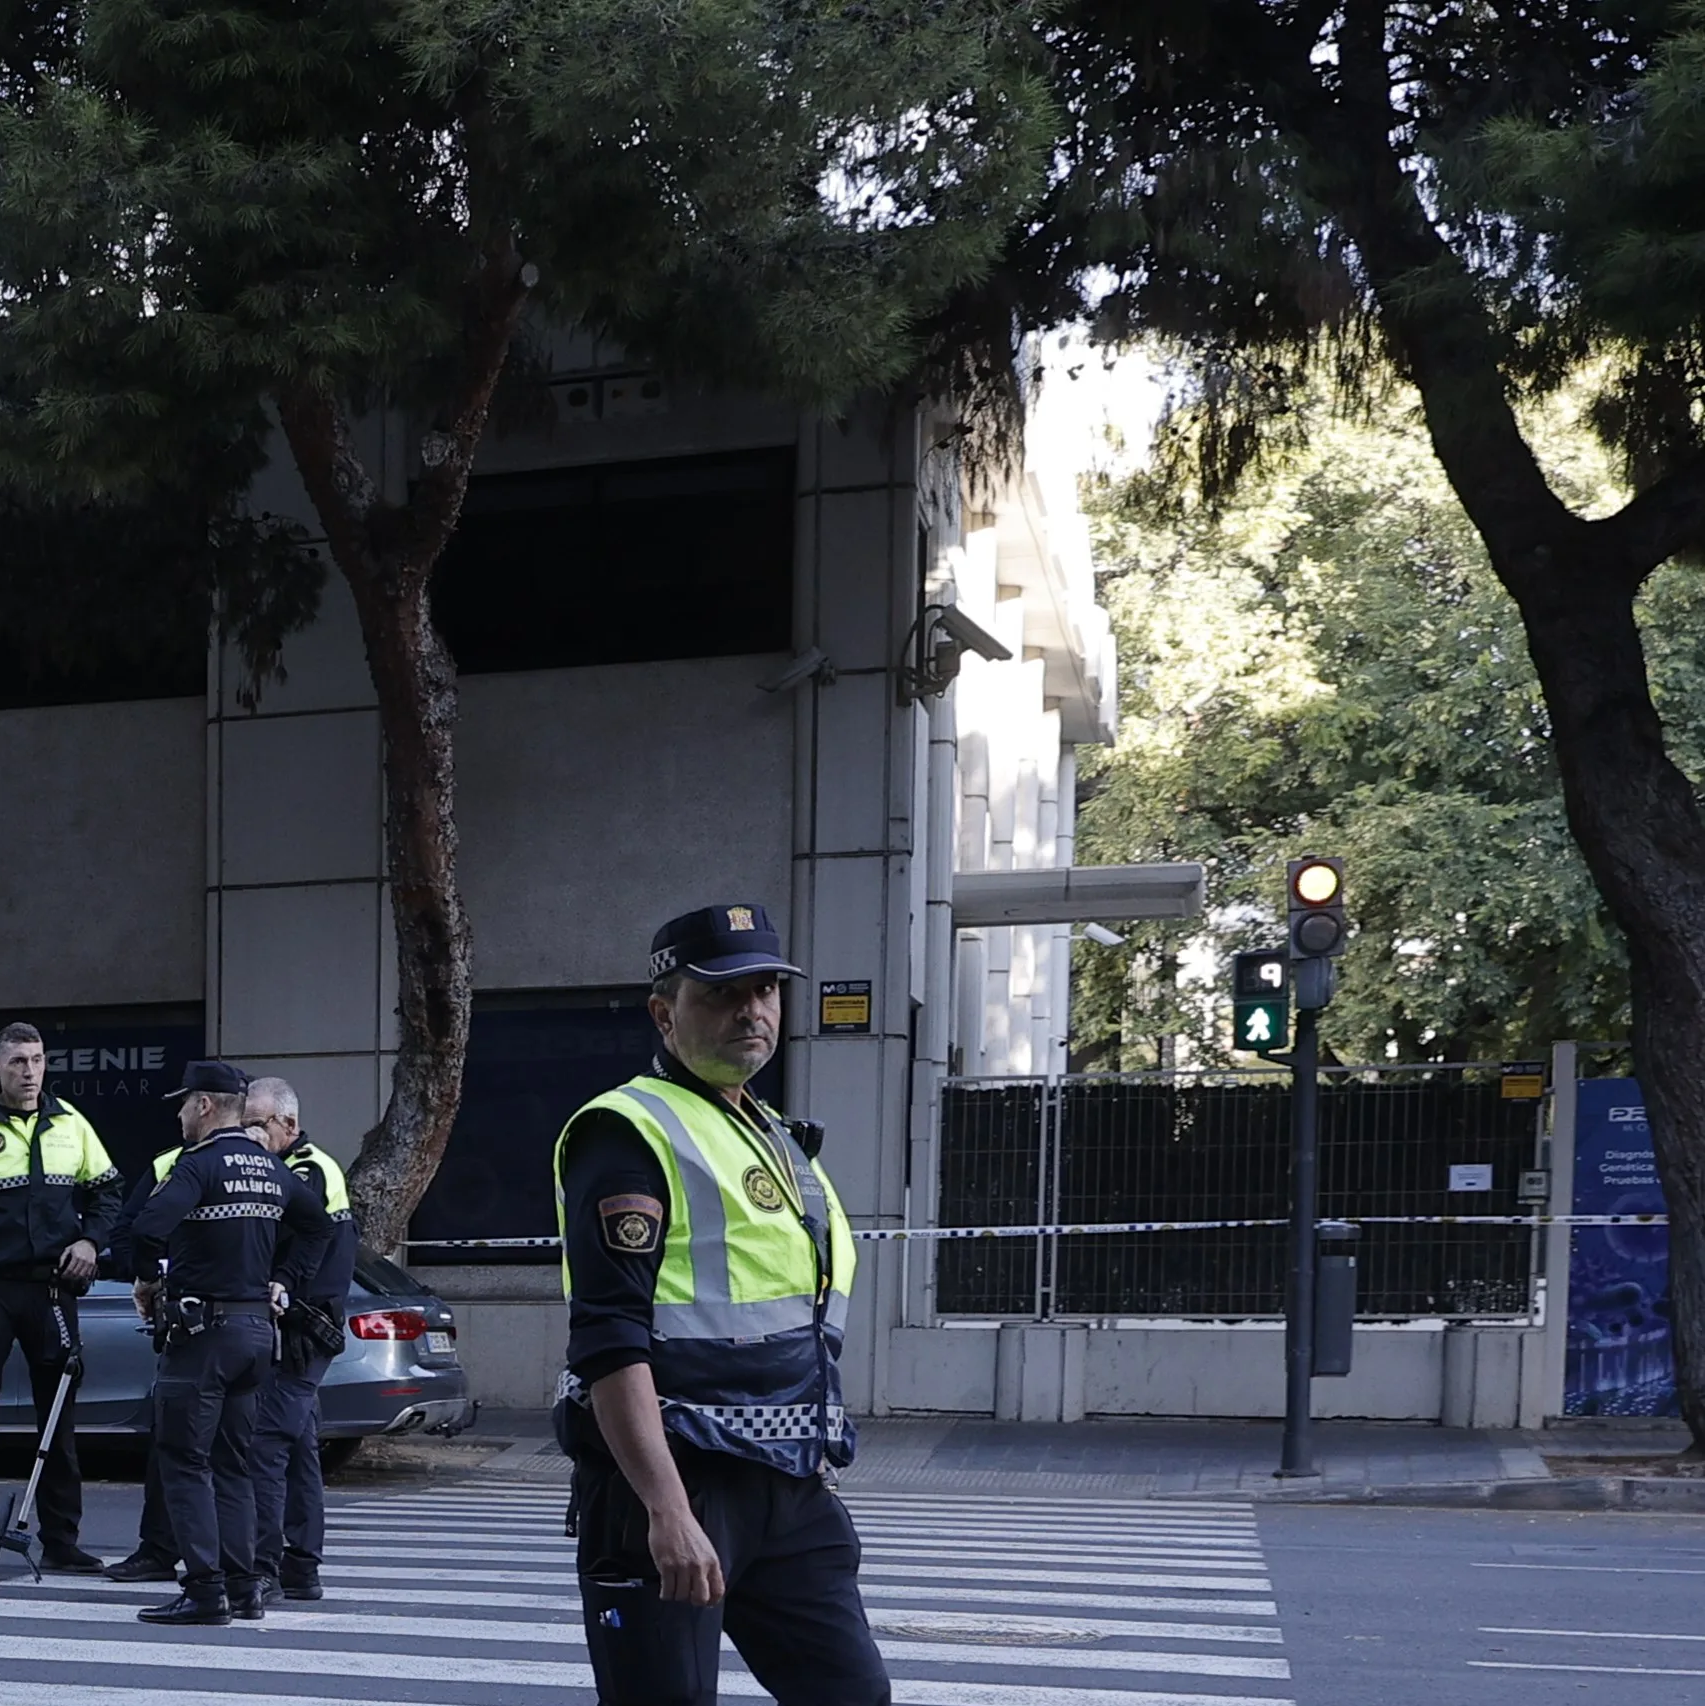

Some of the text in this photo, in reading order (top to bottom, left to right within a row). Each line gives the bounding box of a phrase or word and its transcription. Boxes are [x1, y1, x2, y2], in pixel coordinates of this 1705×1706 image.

[1260, 963, 1282, 987] 9
[222, 1153, 276, 1171] POLICIA
[240, 1166, 268, 1177] LOCAL
